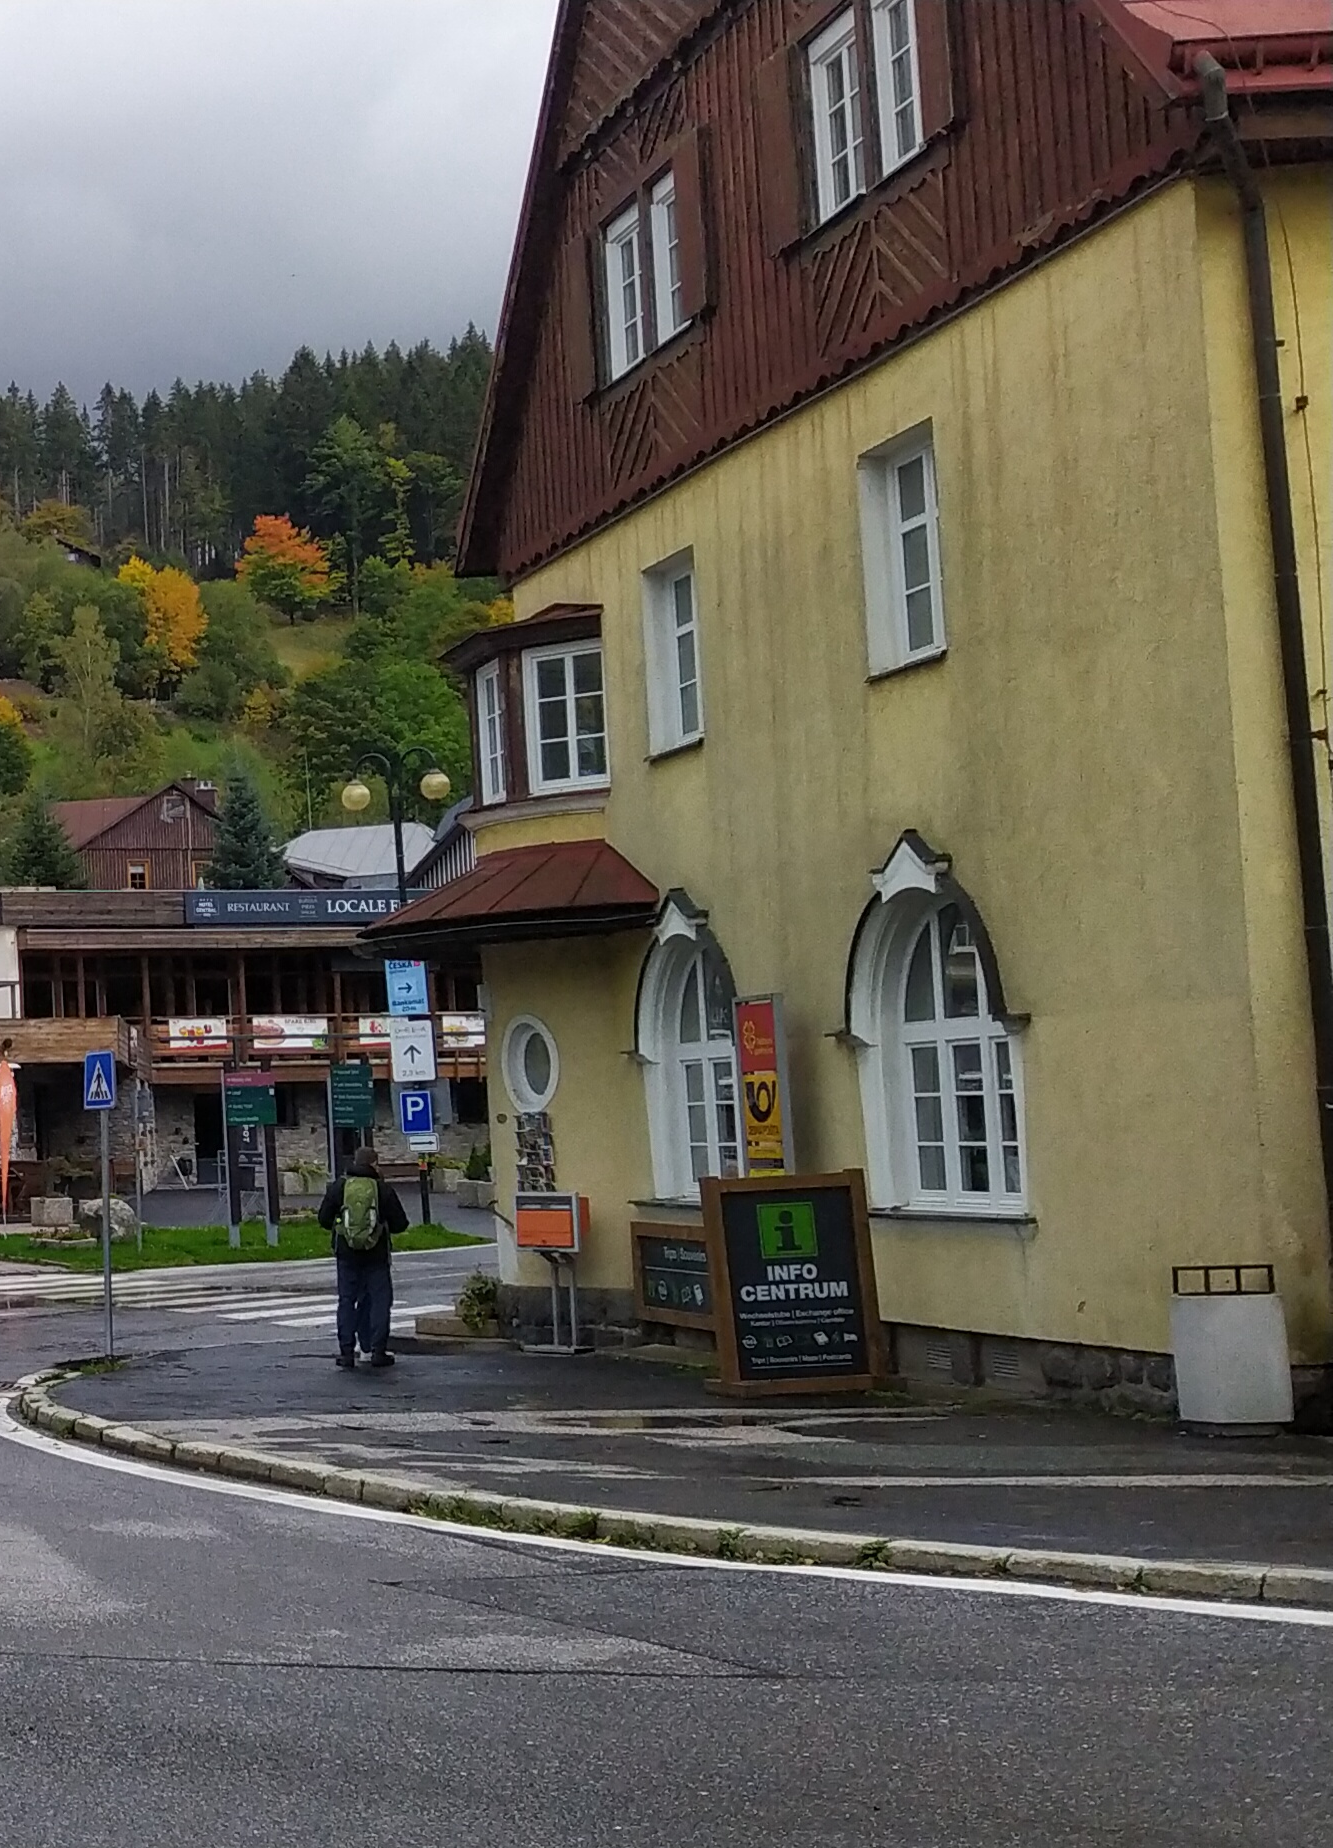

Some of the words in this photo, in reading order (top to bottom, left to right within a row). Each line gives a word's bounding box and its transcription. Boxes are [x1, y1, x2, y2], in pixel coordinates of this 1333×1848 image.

[227, 902, 290, 912] RESTAURANT
[327, 900, 387, 913] LOCALE
[406, 1096, 425, 1121] P
[766, 1263, 818, 1282] INFO
[740, 1281, 849, 1302] CENTRUM
[795, 1309, 832, 1318] Exchange
